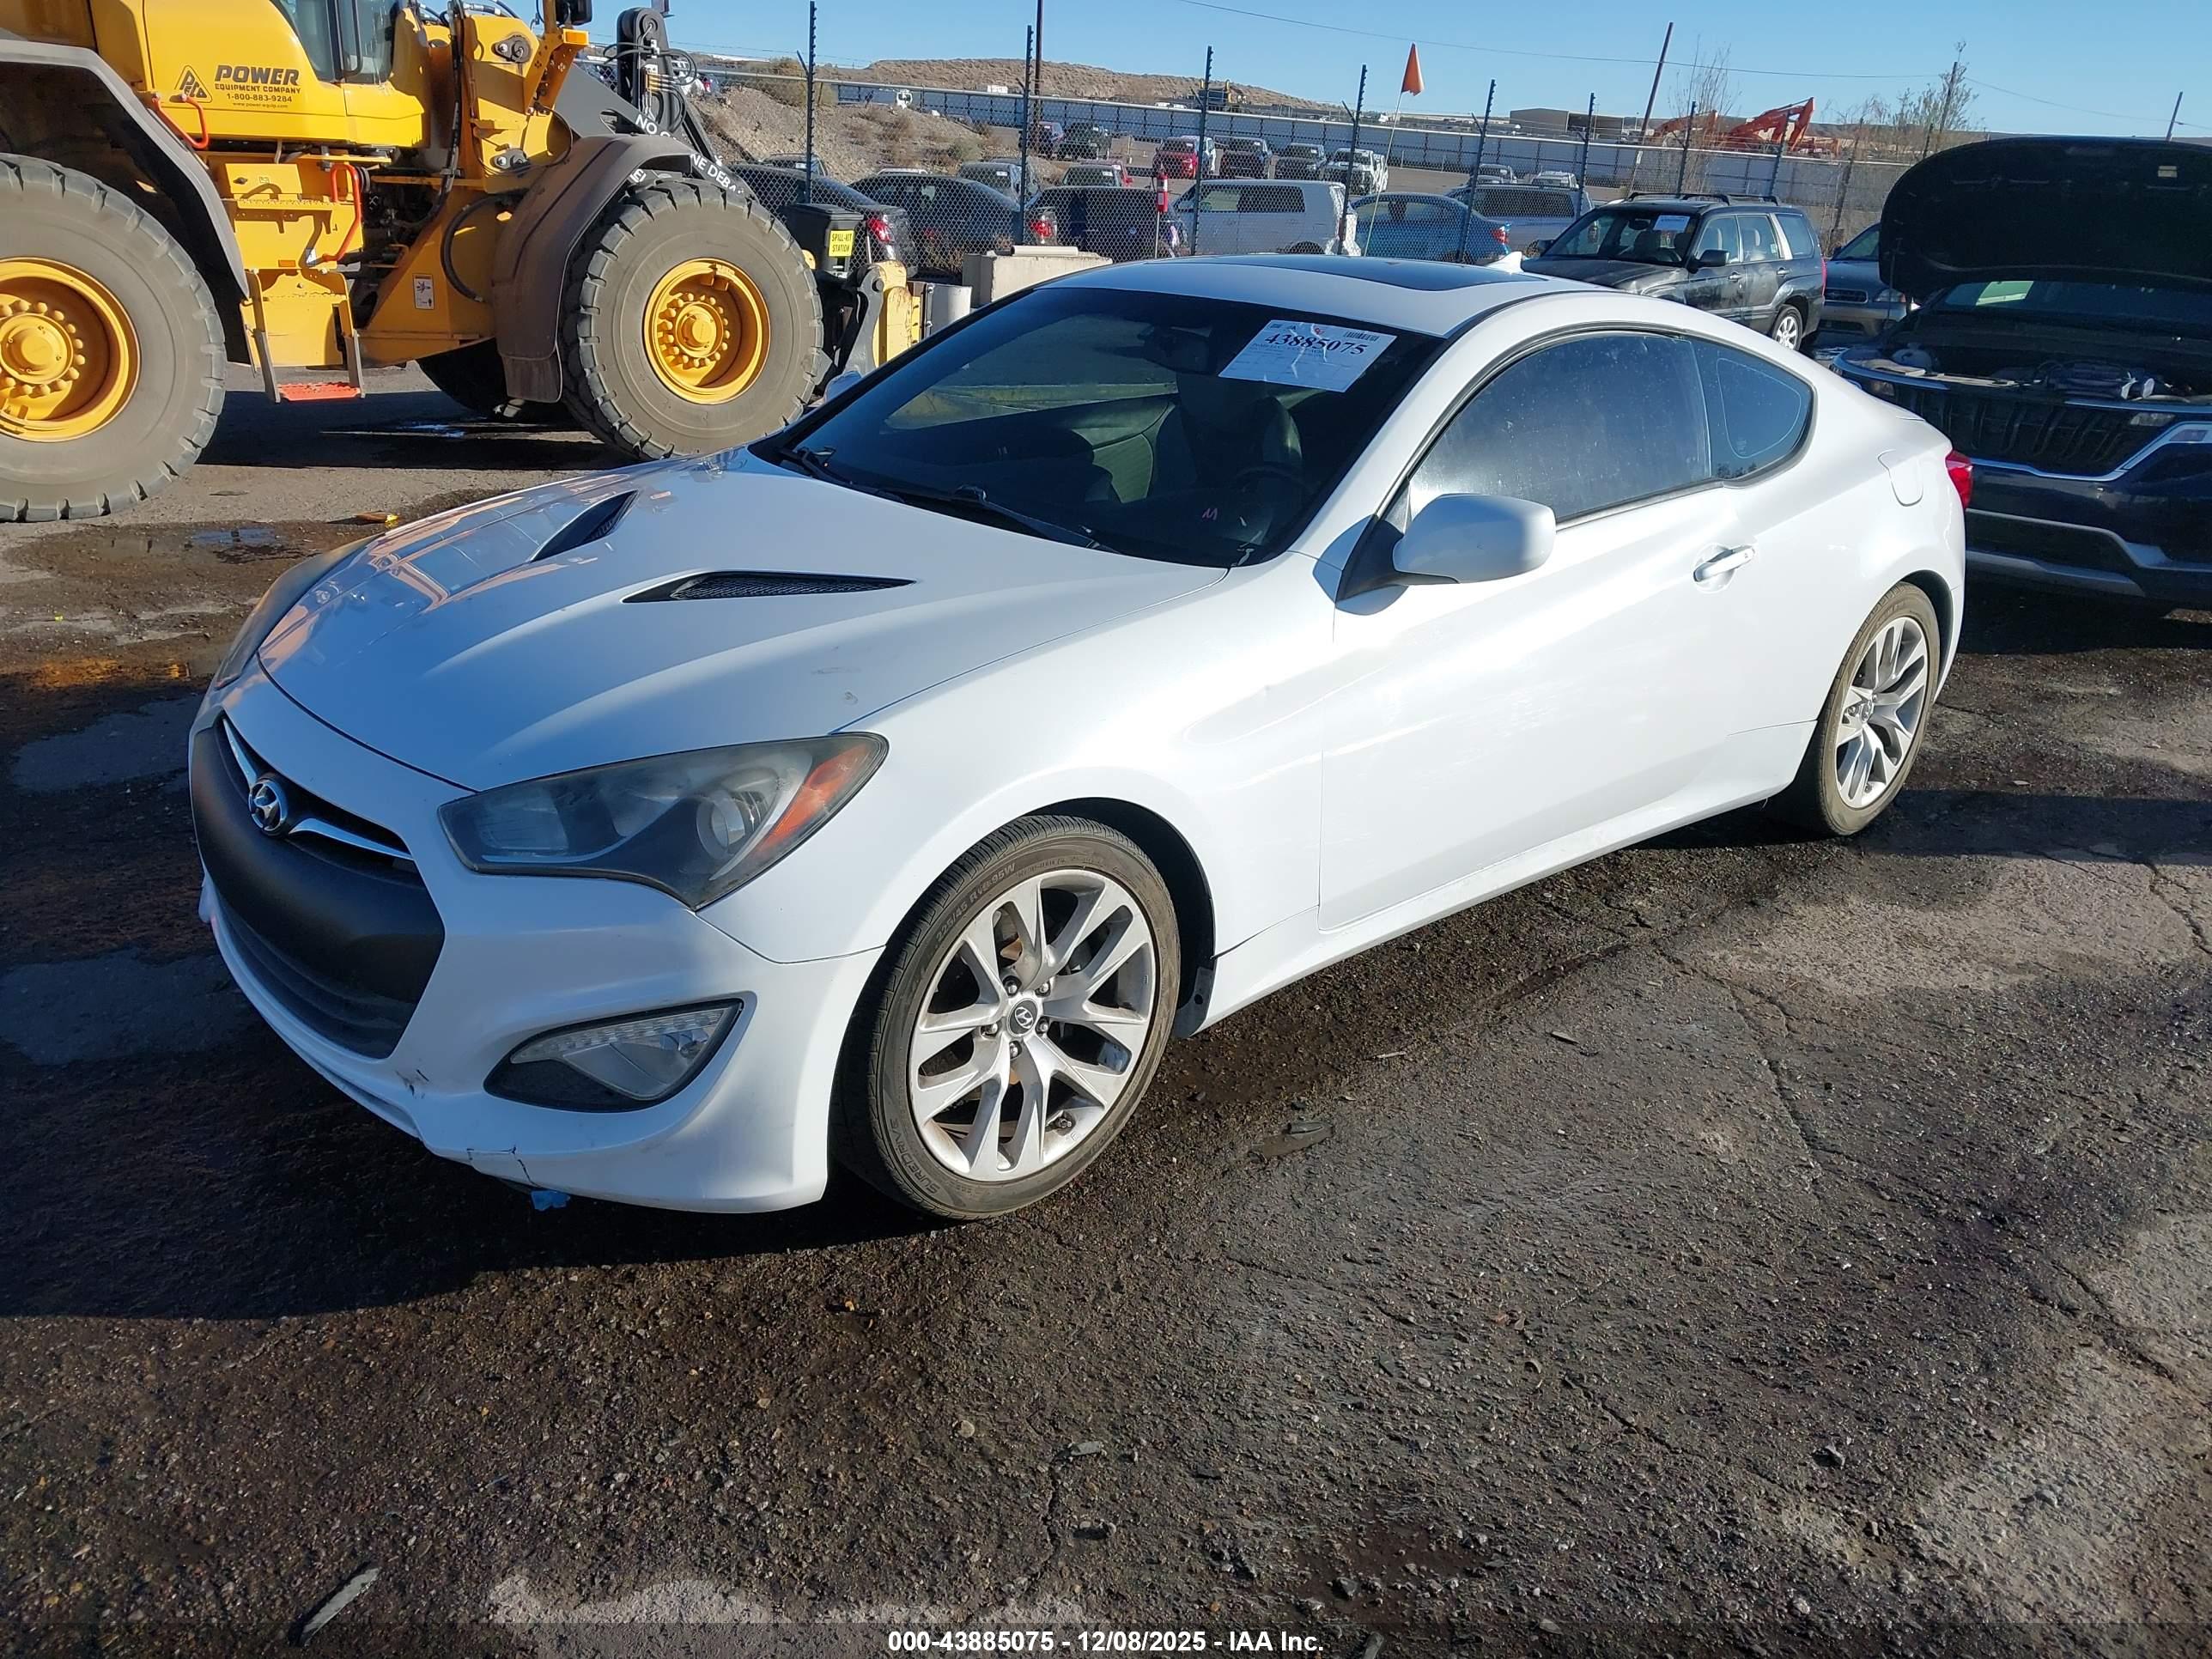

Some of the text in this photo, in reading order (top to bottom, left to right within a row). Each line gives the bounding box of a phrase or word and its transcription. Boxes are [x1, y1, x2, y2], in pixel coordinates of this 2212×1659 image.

[215, 64, 300, 86] POWER
[215, 83, 301, 94] EQUIPMENT COMPANY
[635, 114, 658, 135] NO
[831, 244, 850, 252] STATION
[1265, 332, 1369, 356] 43885075
[890, 1118, 941, 1194] SUREDRIVE
